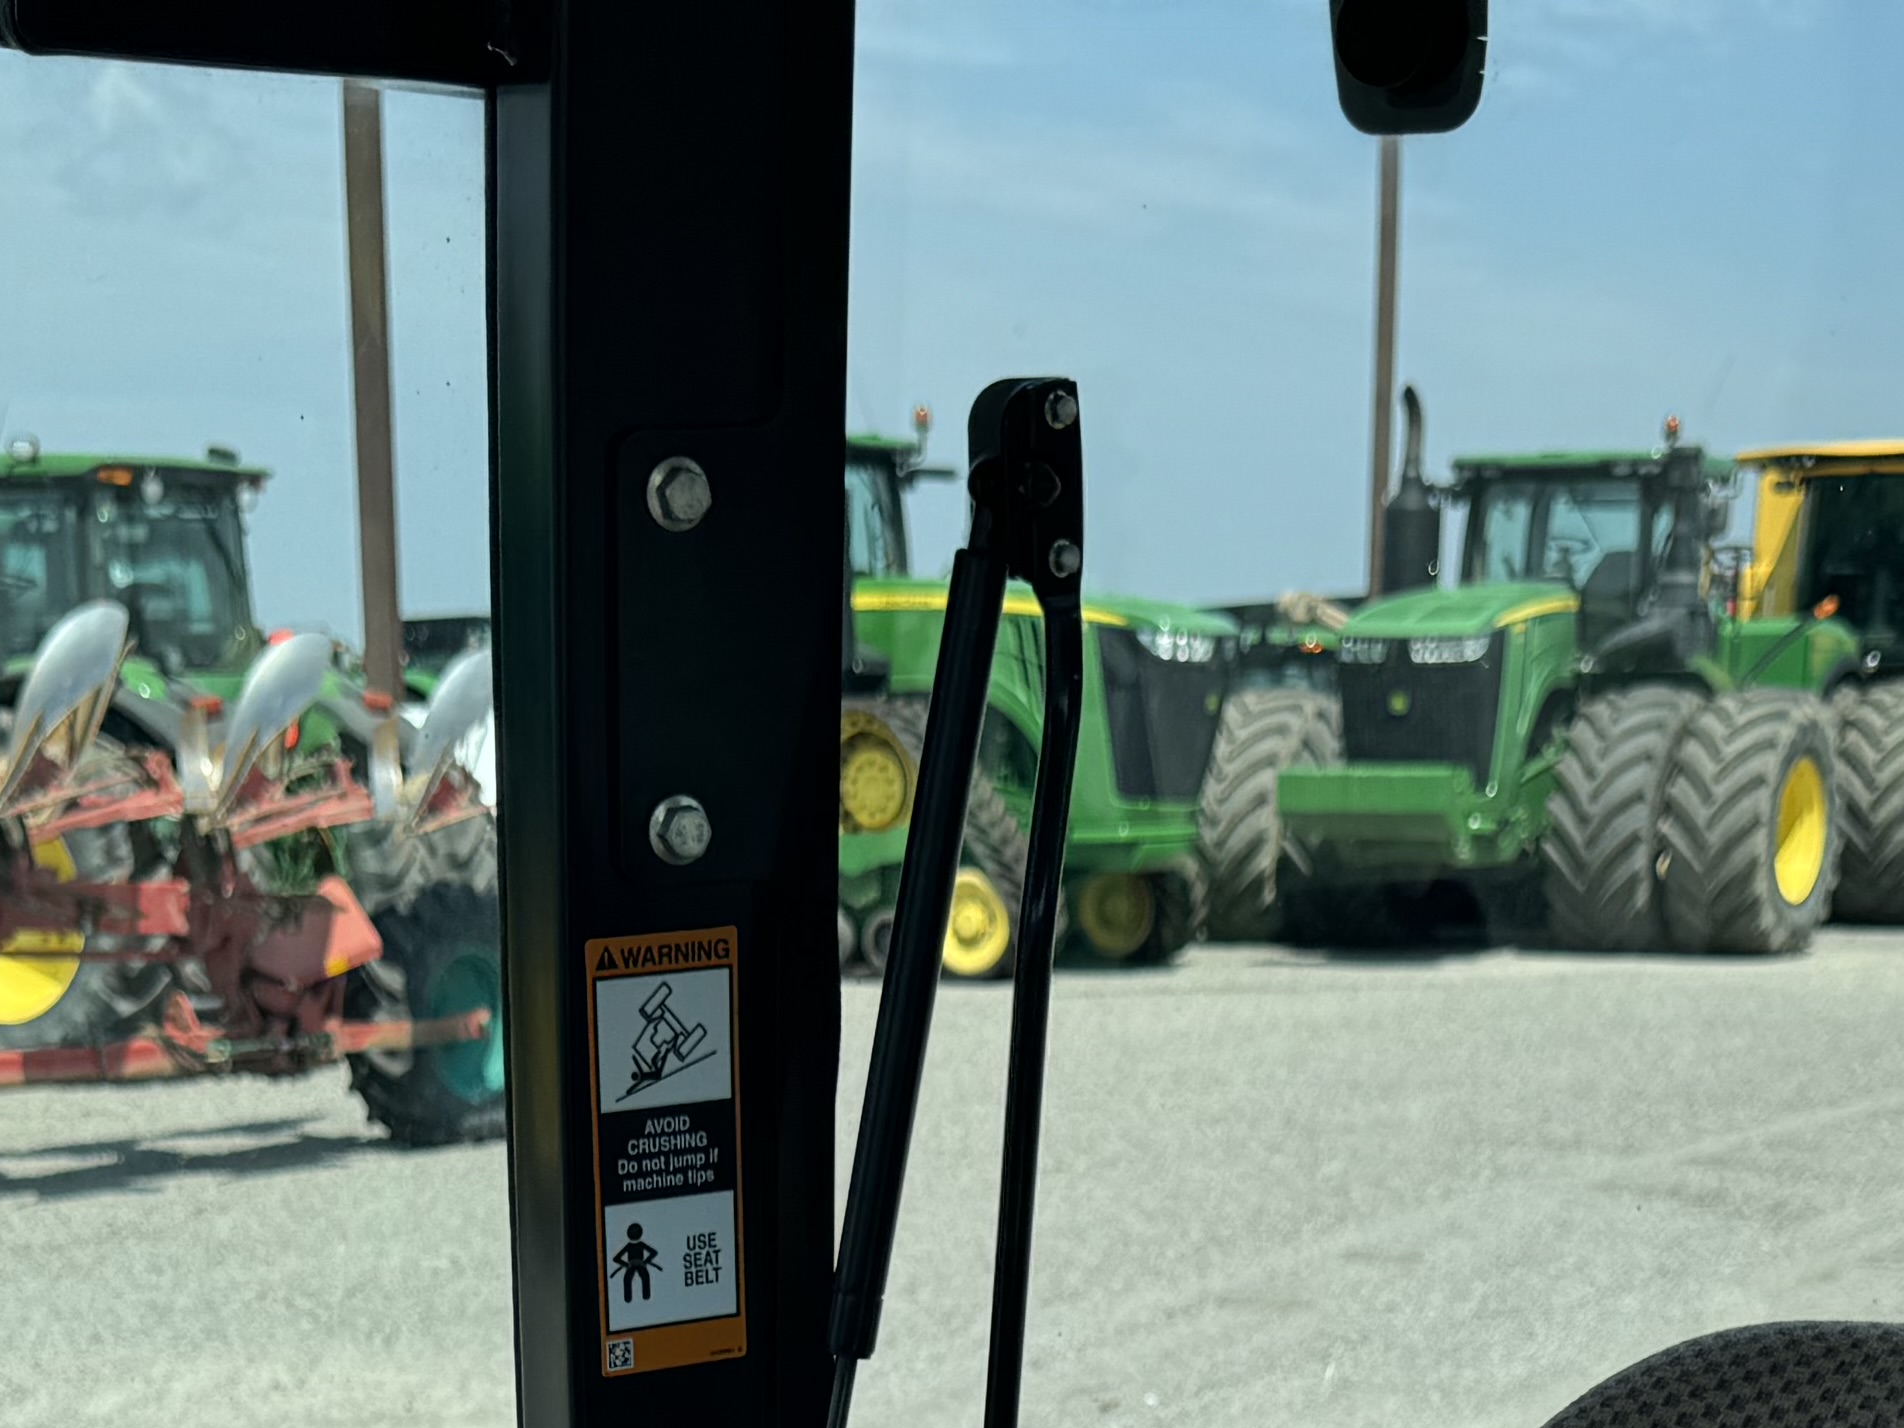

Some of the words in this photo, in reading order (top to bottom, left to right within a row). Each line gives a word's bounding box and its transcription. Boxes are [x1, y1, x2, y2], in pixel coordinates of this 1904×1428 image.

[620, 938, 730, 969] WARNING
[644, 1114, 690, 1135] AVOID
[627, 1130, 708, 1156] CRUSHING
[617, 1158, 638, 1175] Do
[642, 1154, 666, 1172] not
[669, 1152, 706, 1172] jump
[623, 1171, 684, 1192] machine
[687, 1168, 715, 1187] tips
[686, 1232, 717, 1251] USE
[683, 1249, 722, 1269] SEAT
[684, 1266, 722, 1287] BELT
